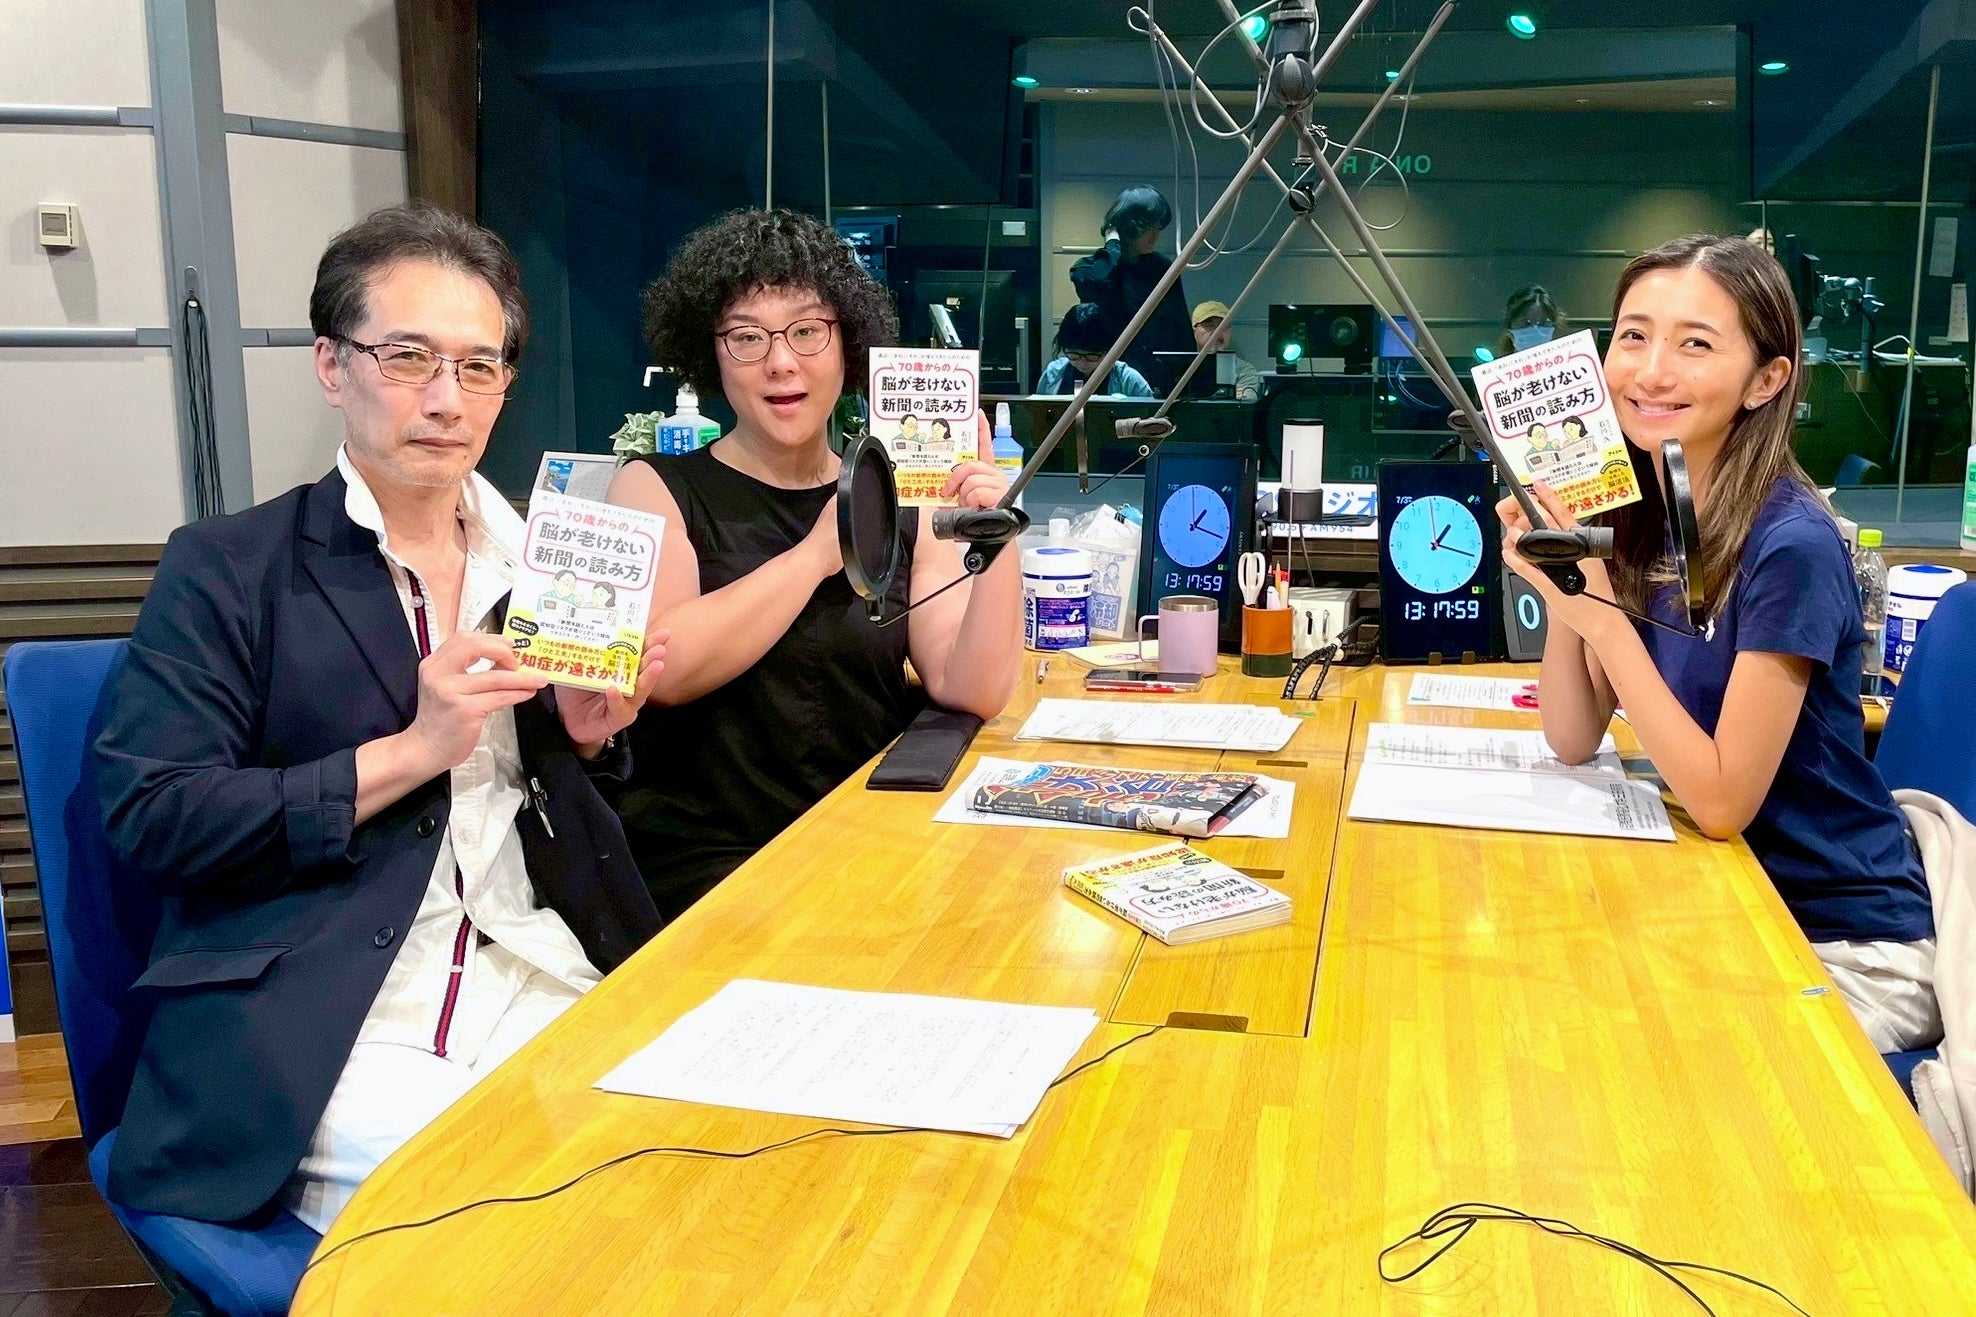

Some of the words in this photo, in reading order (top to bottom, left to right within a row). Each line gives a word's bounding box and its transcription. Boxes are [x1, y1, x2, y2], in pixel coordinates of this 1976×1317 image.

[898, 362, 951, 373] 70歳からの
[1505, 355, 1564, 380] 70歳からの
[881, 376, 967, 392] 脳が老けない
[1493, 366, 1587, 408] 脳が老けない
[881, 397, 968, 414] 新聞の読み方
[1500, 388, 1595, 430] 新聞の読み方
[565, 510, 630, 532] 70歳からの
[539, 521, 645, 556] 脳が老けない
[534, 546, 642, 582] 新聞の読み方
[1165, 572, 1223, 592] 13:17:59
[1404, 599, 1479, 620] 13:17:59
[1518, 593, 1540, 630] 0
